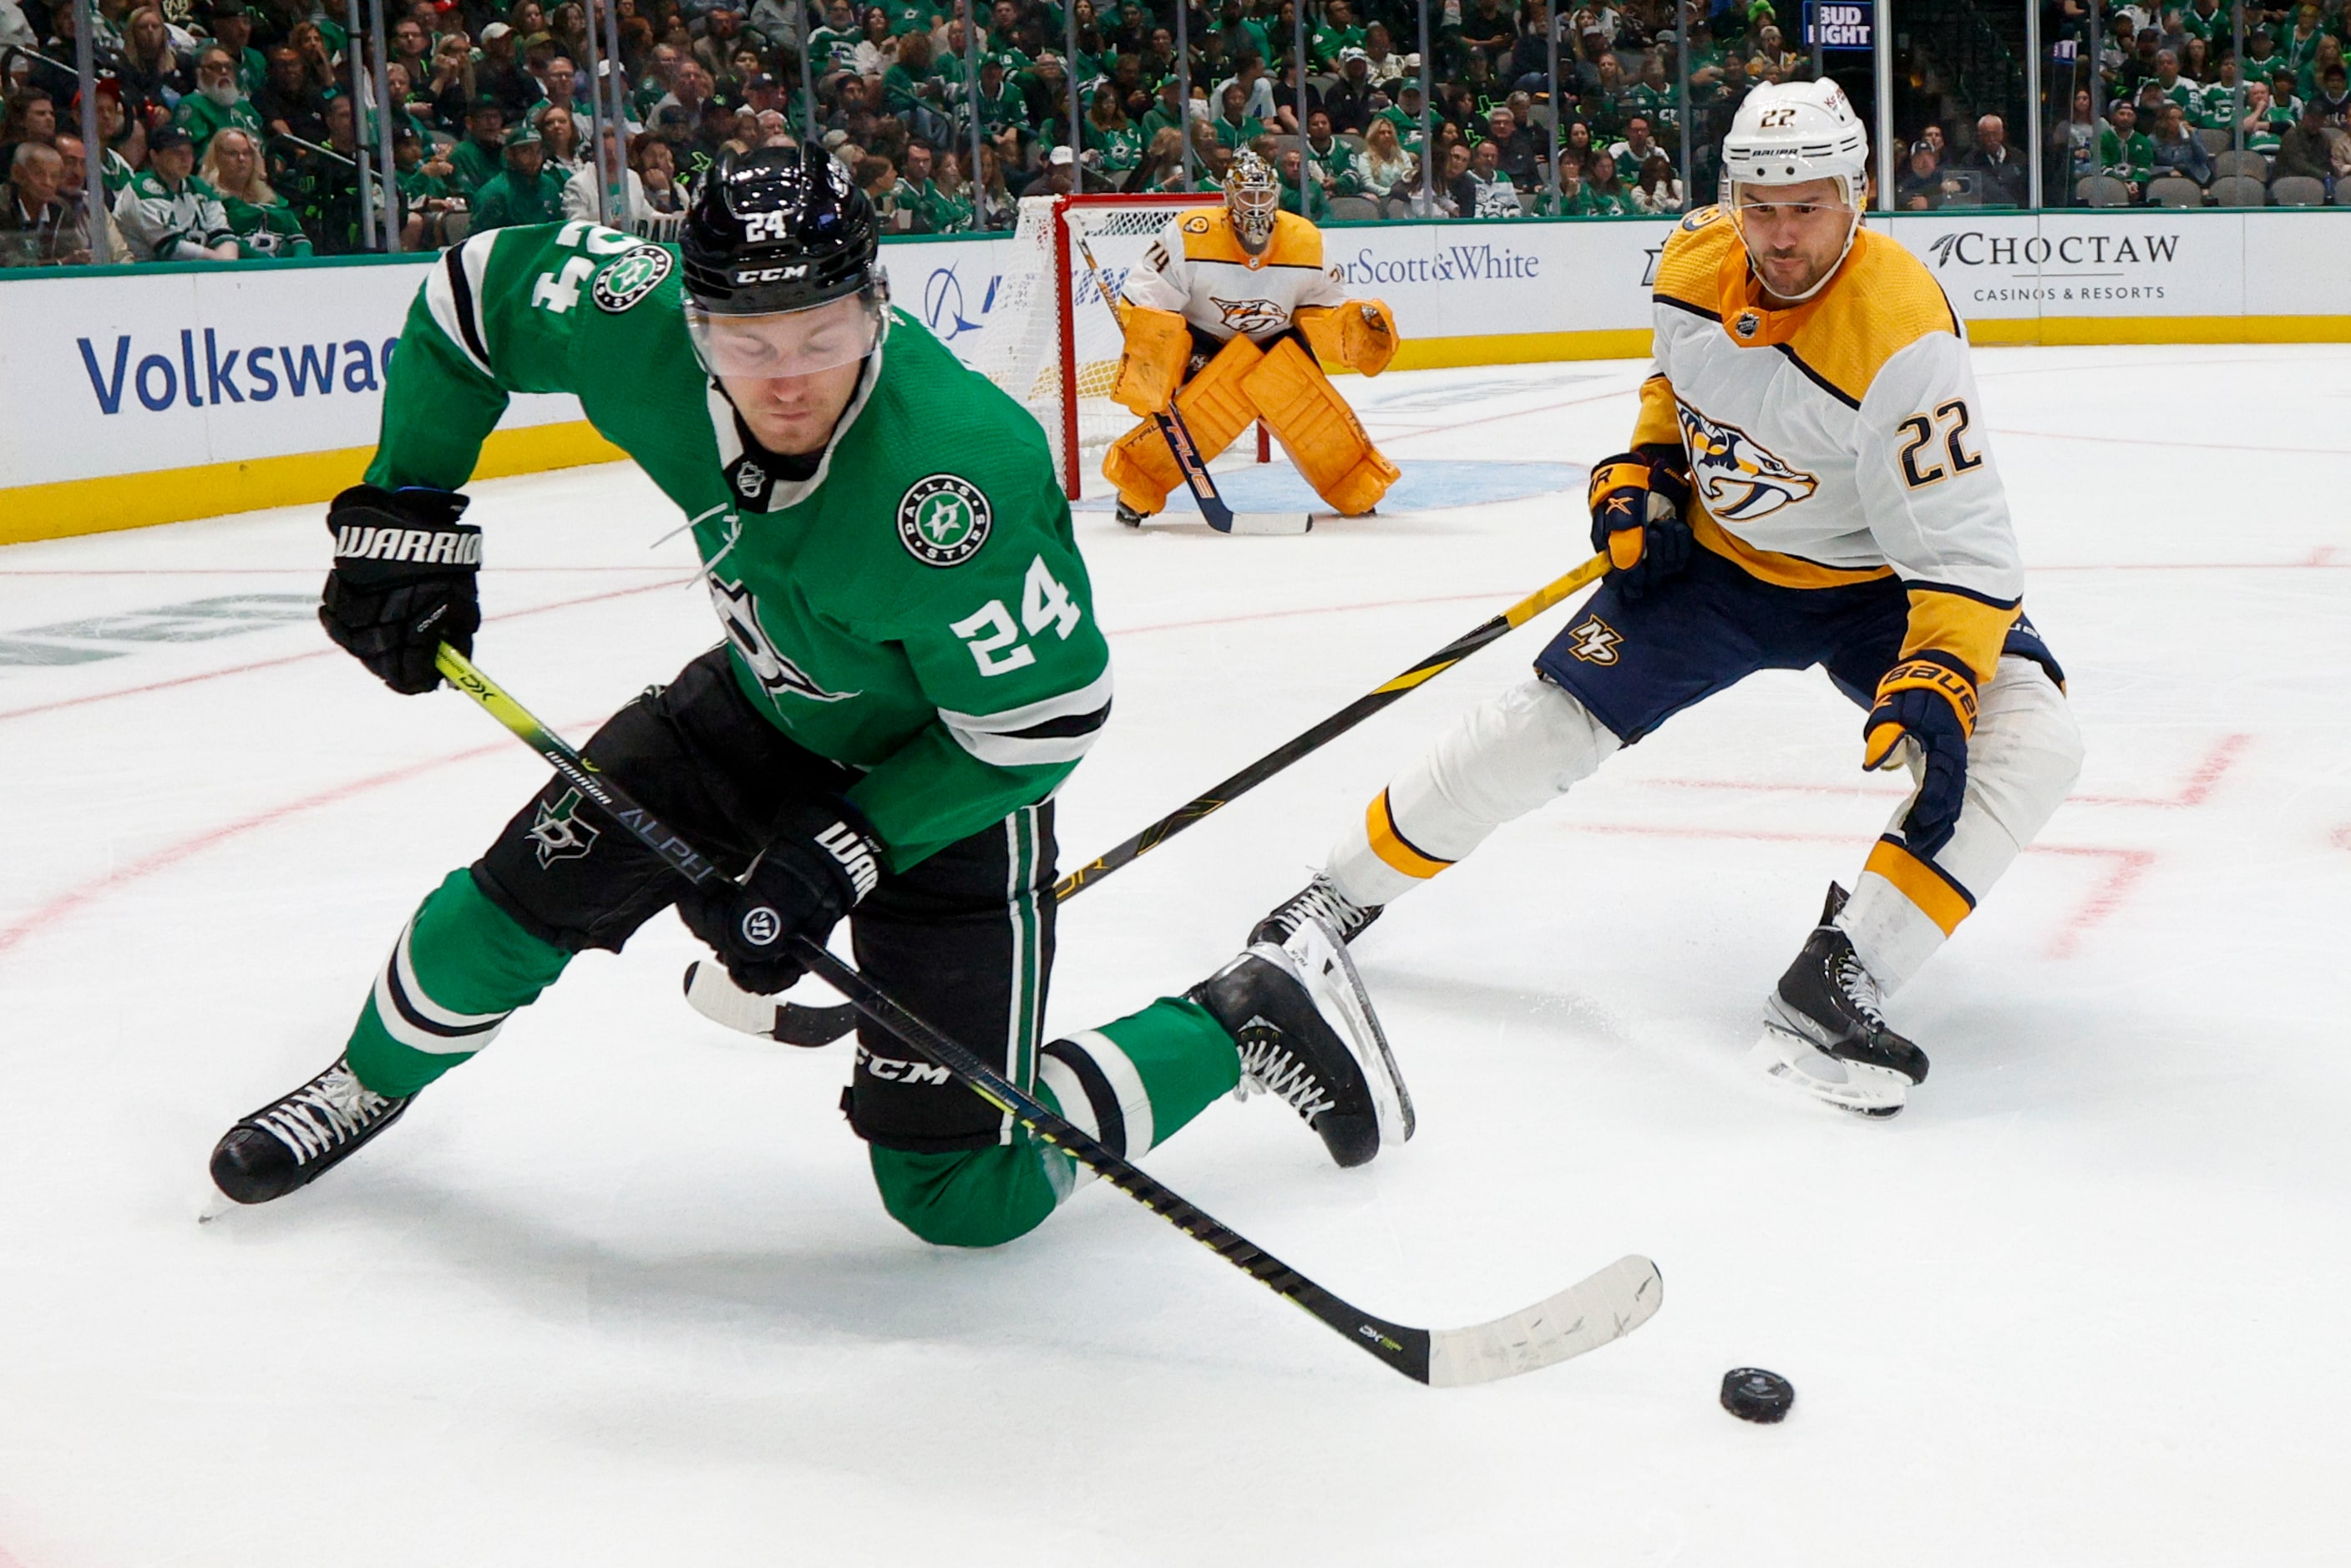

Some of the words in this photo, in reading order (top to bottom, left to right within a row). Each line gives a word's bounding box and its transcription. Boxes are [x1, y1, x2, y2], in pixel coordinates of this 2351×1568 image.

[1820, 6, 1862, 25] BUD
[1760, 109, 1796, 129] 22
[745, 210, 787, 243] 24
[1955, 232, 2181, 266] CHOCTAW
[736, 264, 808, 284] CCM
[1974, 288, 2056, 301] CASINOS
[2063, 289, 2080, 299] &
[2080, 286, 2165, 299] RESORTS
[1166, 416, 1215, 500] TRUE
[1894, 397, 1984, 492] 22
[904, 481, 971, 536] DALLAS
[925, 512, 986, 560] STARS
[949, 553, 1082, 677] 24
